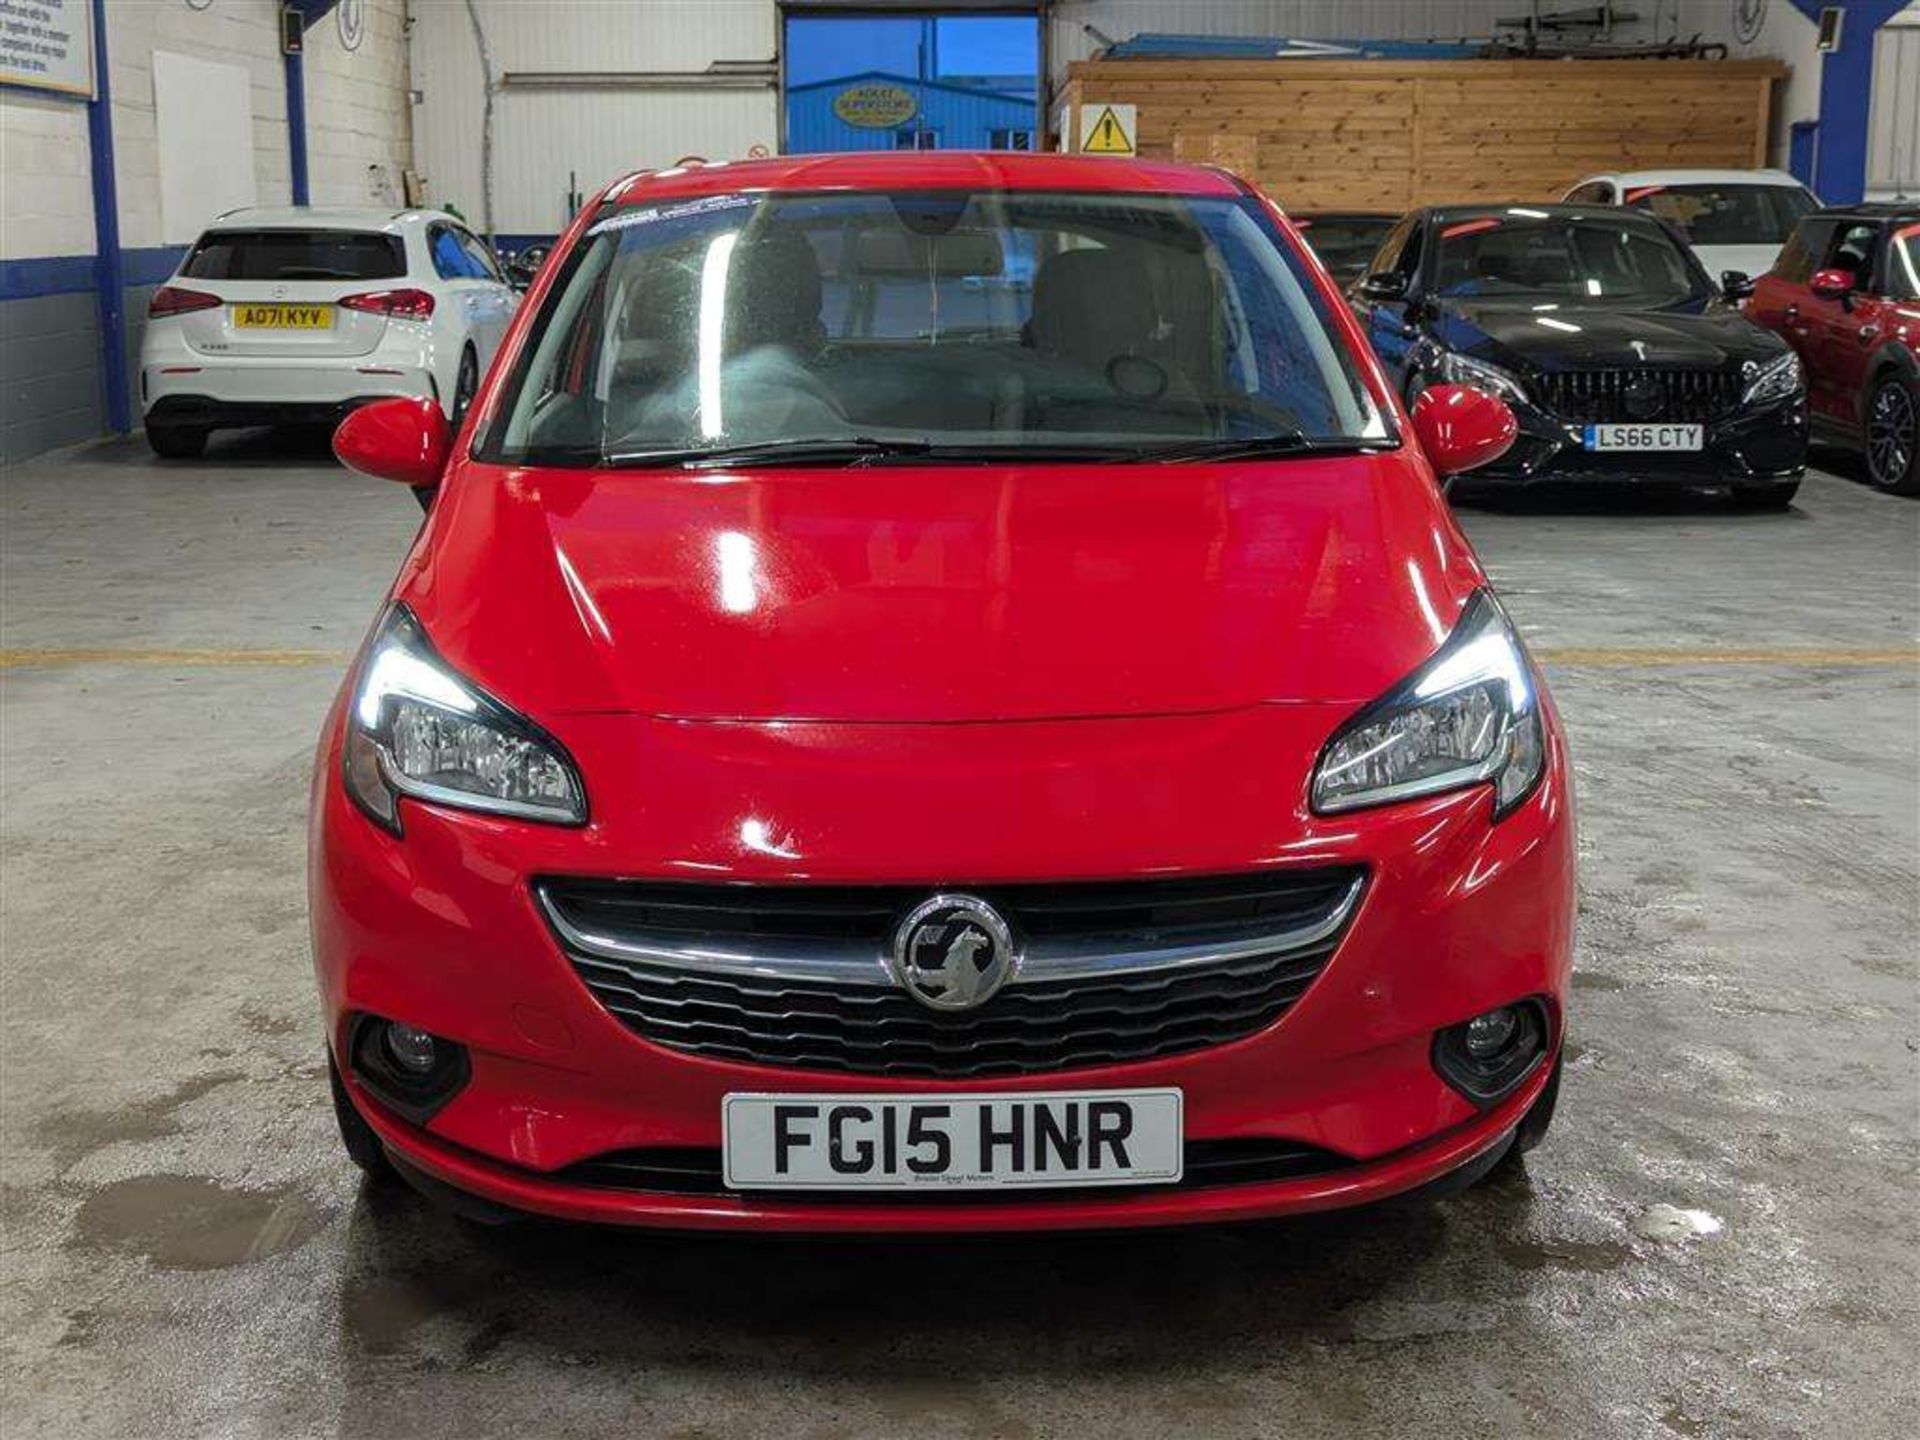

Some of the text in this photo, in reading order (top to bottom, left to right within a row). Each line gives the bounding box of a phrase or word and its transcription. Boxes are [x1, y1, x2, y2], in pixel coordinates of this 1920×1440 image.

[287, 309, 320, 325] KYV
[1600, 428, 1698, 447] LS66 CTY
[774, 1100, 1133, 1174] FG15 HNR
